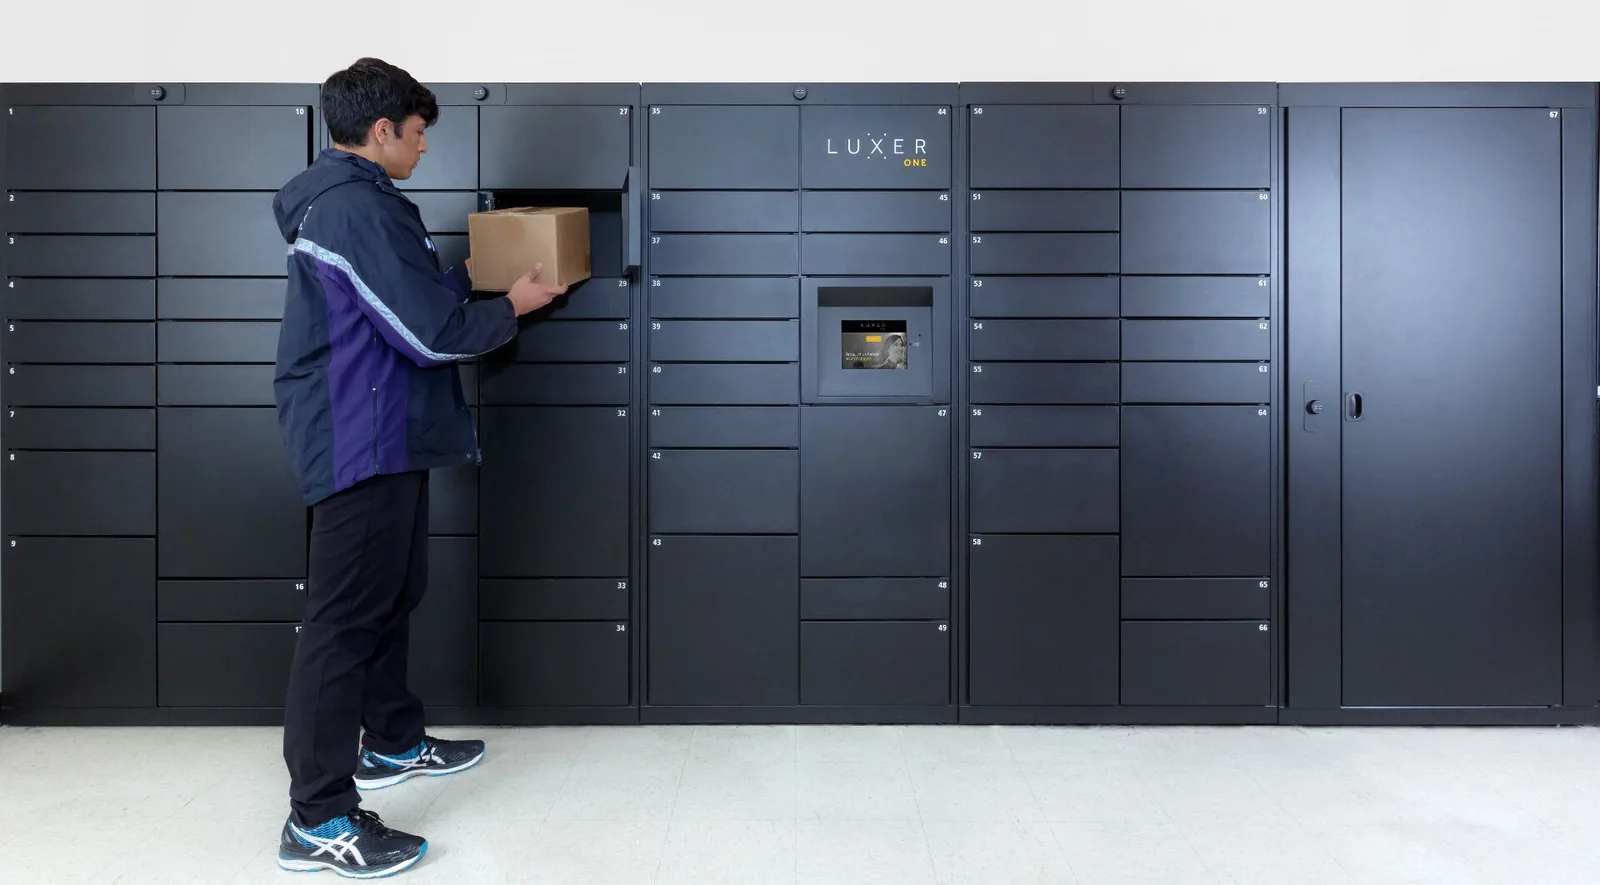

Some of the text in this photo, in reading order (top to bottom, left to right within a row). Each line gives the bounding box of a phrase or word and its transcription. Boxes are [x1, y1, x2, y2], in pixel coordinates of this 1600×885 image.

[7, 107, 13, 116] 1
[294, 107, 305, 116] 10
[618, 107, 629, 116] 27
[650, 107, 661, 116] 35
[937, 107, 947, 116] 44
[973, 107, 983, 116] 50
[1257, 107, 1268, 116] 59
[1548, 110, 1559, 119] 67
[827, 138, 927, 155] LUXER
[903, 159, 927, 167] ONE
[8, 194, 15, 203] 2
[650, 192, 661, 201] 36
[938, 193, 949, 202] 45
[972, 192, 982, 201] 51
[1258, 193, 1269, 201] 60
[8, 237, 15, 246] 3
[650, 236, 661, 245] 37
[938, 237, 949, 245] 46
[972, 236, 982, 245] 52
[8, 281, 15, 289] 4
[617, 279, 628, 288] 29
[650, 279, 661, 288] 38
[973, 279, 983, 288] 53
[1257, 279, 1268, 288] 61
[8, 324, 15, 333] 5
[617, 322, 628, 331] 30
[650, 322, 661, 331] 39
[973, 322, 983, 331] 54
[1258, 322, 1268, 331] 62
[8, 367, 15, 376] 6
[617, 366, 627, 375] 31
[651, 366, 662, 375] 40
[972, 365, 983, 374] 55
[1258, 365, 1268, 374] 63
[9, 410, 16, 418] 7
[616, 409, 627, 418] 32
[651, 409, 661, 418] 41
[937, 409, 947, 418] 47
[972, 408, 982, 417] 56
[1257, 408, 1268, 417] 64
[9, 453, 16, 462] 8
[651, 452, 662, 461] 42
[972, 451, 982, 460] 57
[10, 539, 17, 548] 9
[651, 538, 662, 547] 43
[972, 537, 982, 547] 58
[294, 582, 305, 591] 16
[616, 581, 627, 590] 33
[937, 581, 948, 590] 48
[1258, 580, 1269, 589] 65
[615, 624, 626, 633] 34
[937, 623, 948, 633] 49
[1258, 623, 1269, 632] 66
